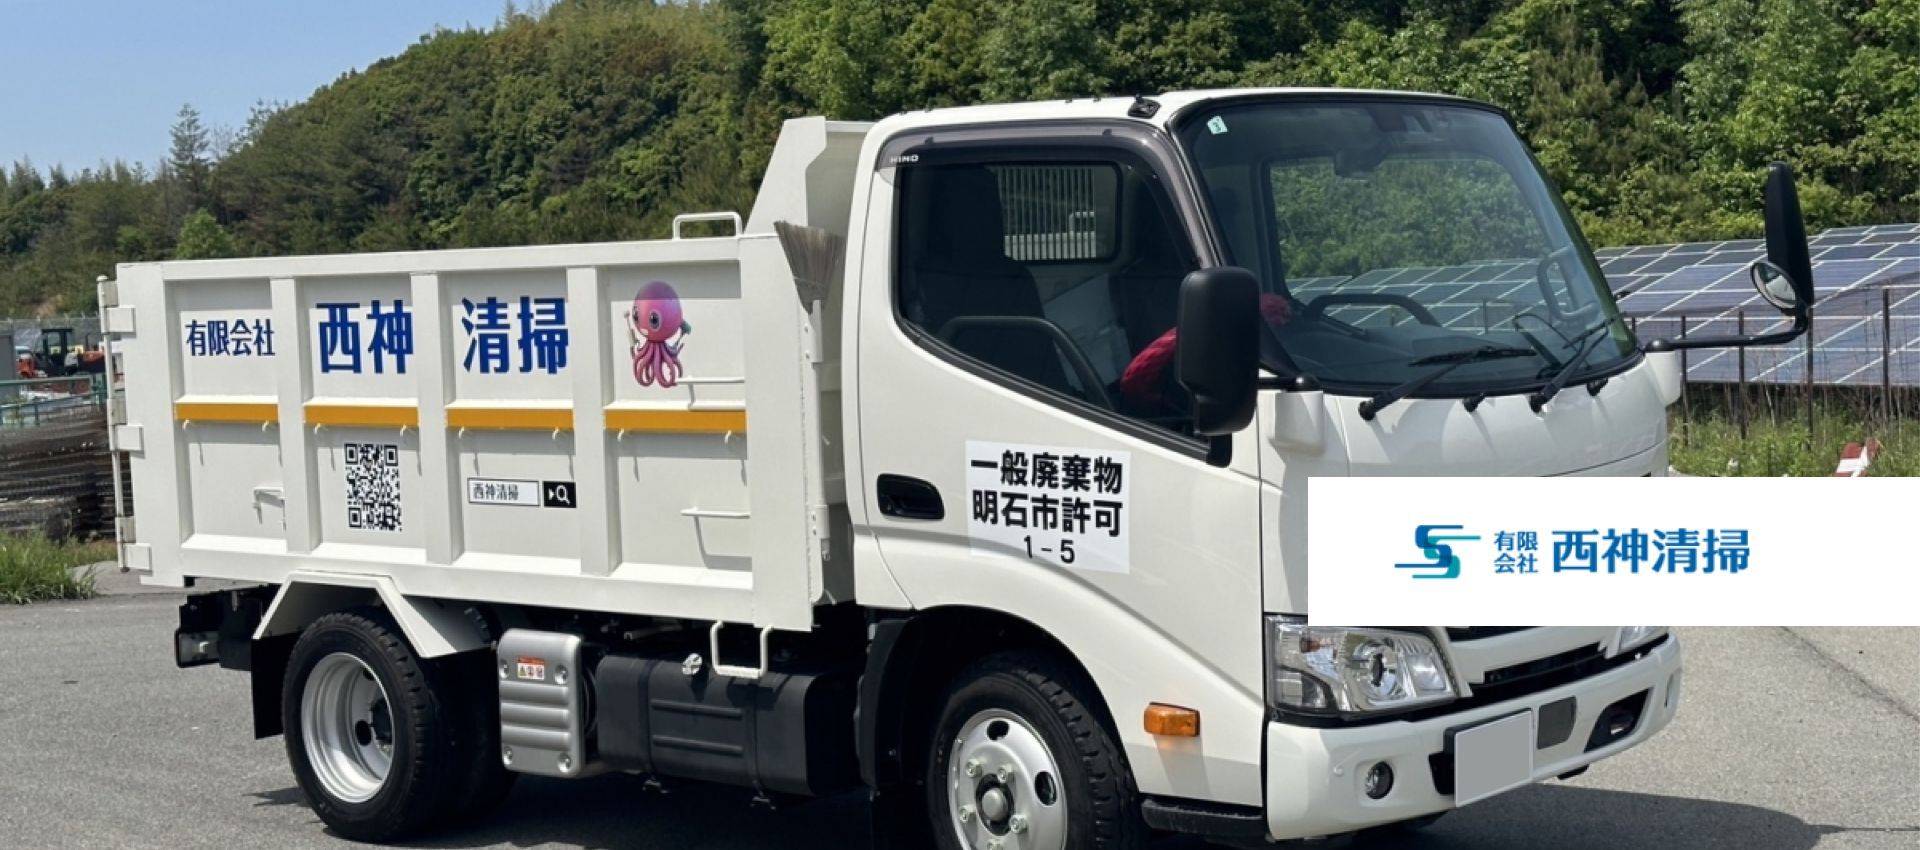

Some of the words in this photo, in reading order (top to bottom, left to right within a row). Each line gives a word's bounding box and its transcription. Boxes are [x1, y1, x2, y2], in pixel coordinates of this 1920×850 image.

[890, 154, 919, 163] HINO
[185, 319, 275, 356] 有限会社
[971, 449, 1123, 495] 一般廃棄物
[473, 483, 518, 500] 西神清掃
[972, 489, 1123, 537] 明石市許可
